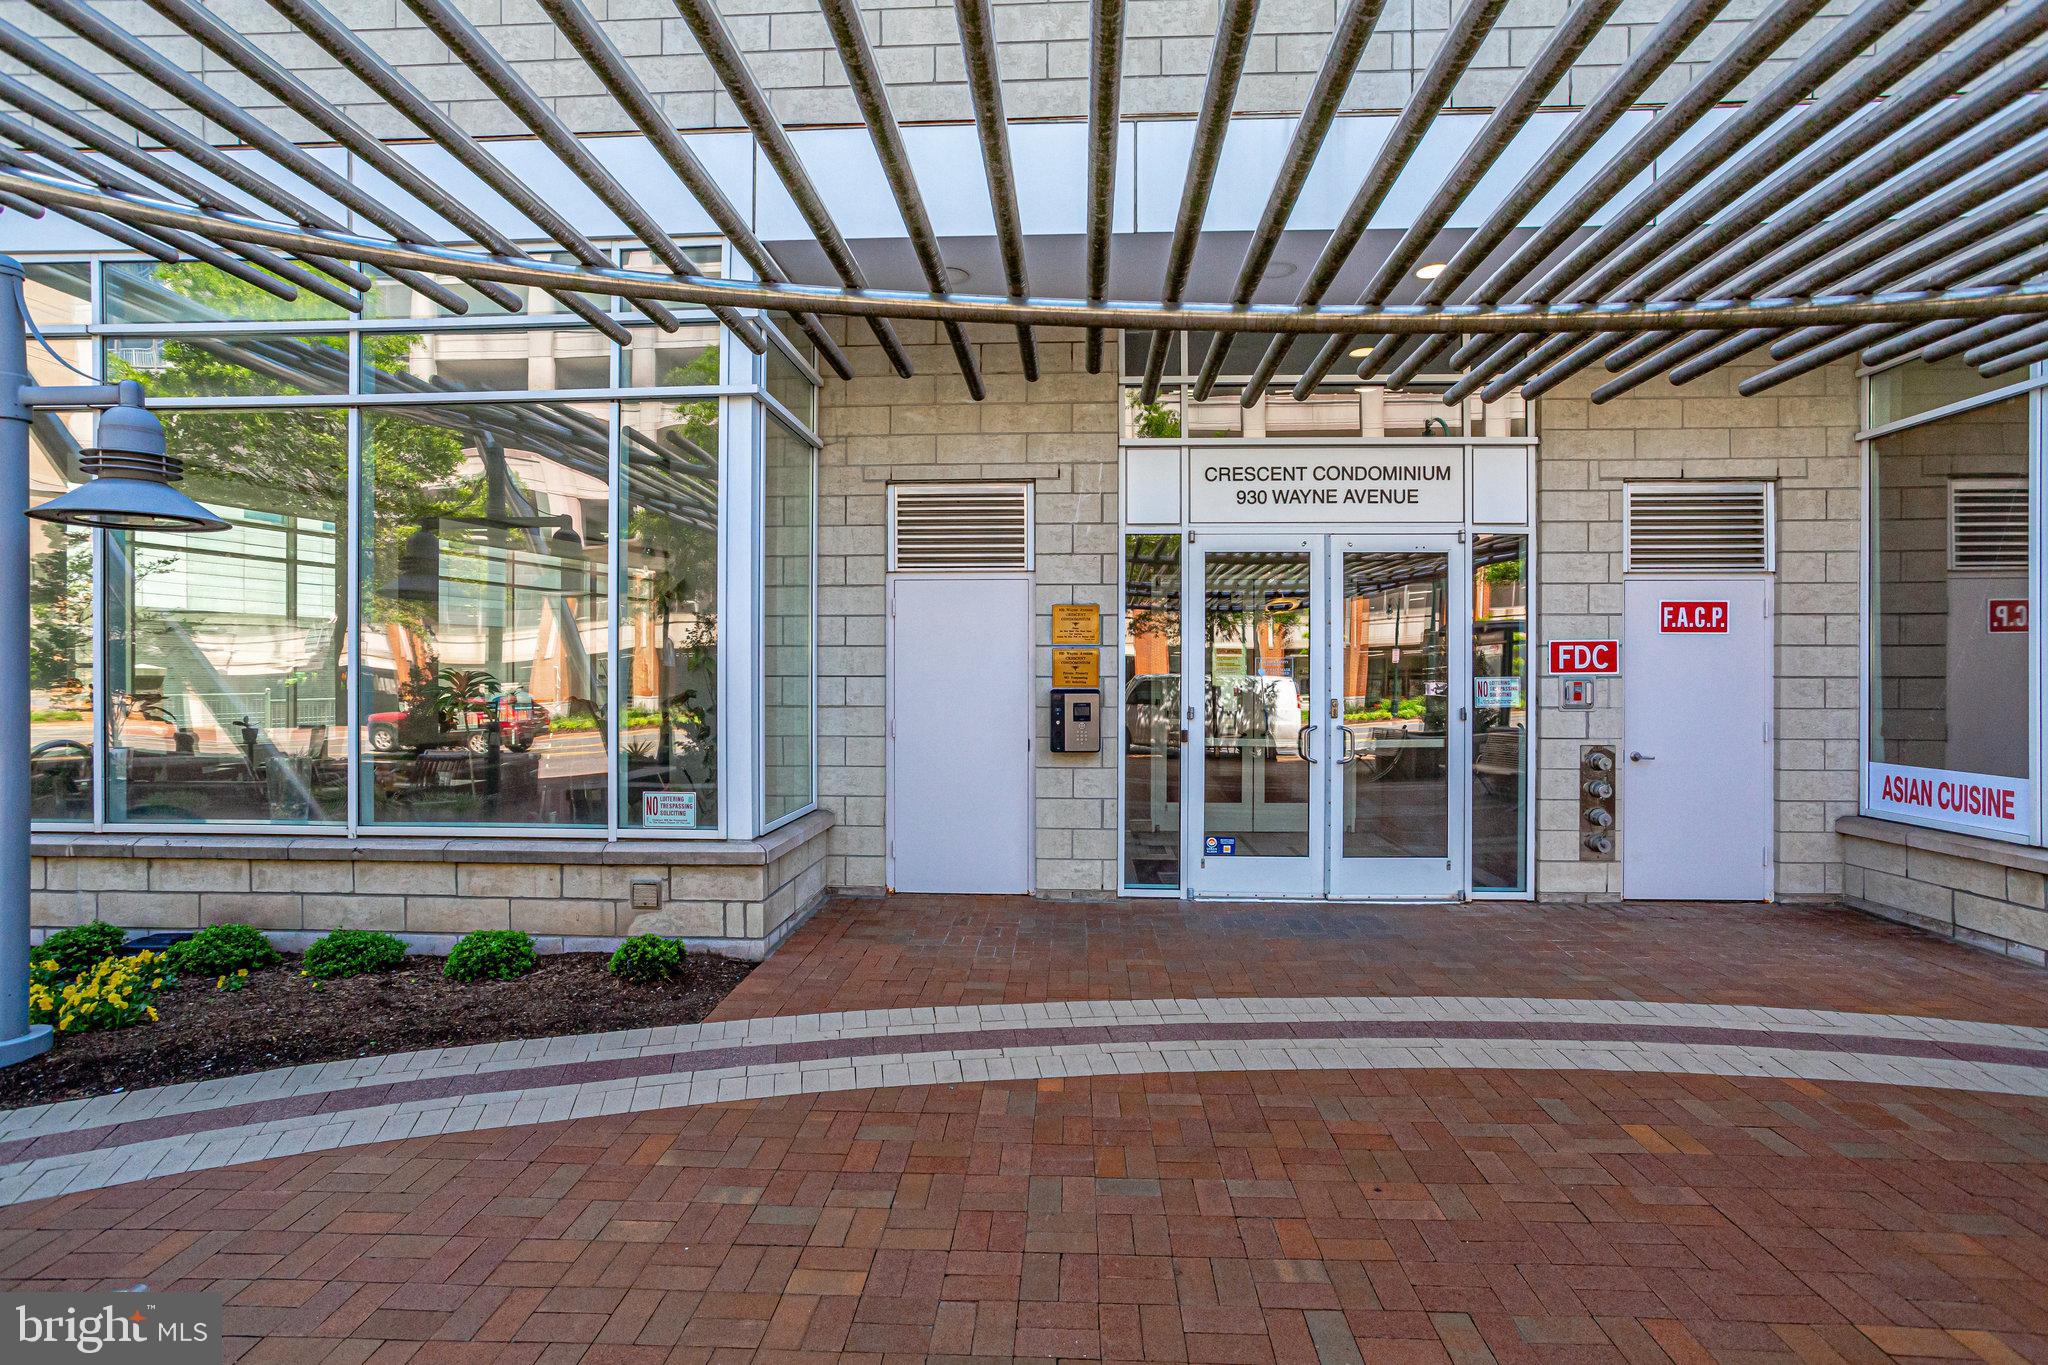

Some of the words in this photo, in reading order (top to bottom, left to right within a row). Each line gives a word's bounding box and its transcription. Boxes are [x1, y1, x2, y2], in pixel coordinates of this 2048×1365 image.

[1204, 466, 1307, 482] CRESCENT
[1312, 465, 1451, 482] CONDOMINIUM
[1236, 489, 1268, 505] 930
[1272, 489, 1338, 504] WAYNE
[1343, 488, 1419, 504] AVENUE
[1663, 606, 1725, 628] F.A.C.P.
[1559, 644, 1609, 670] FDC
[1477, 680, 1489, 698] NO
[646, 796, 659, 816] NO
[1882, 774, 1932, 807] ASIAN
[1938, 781, 2015, 820] CUISINE
